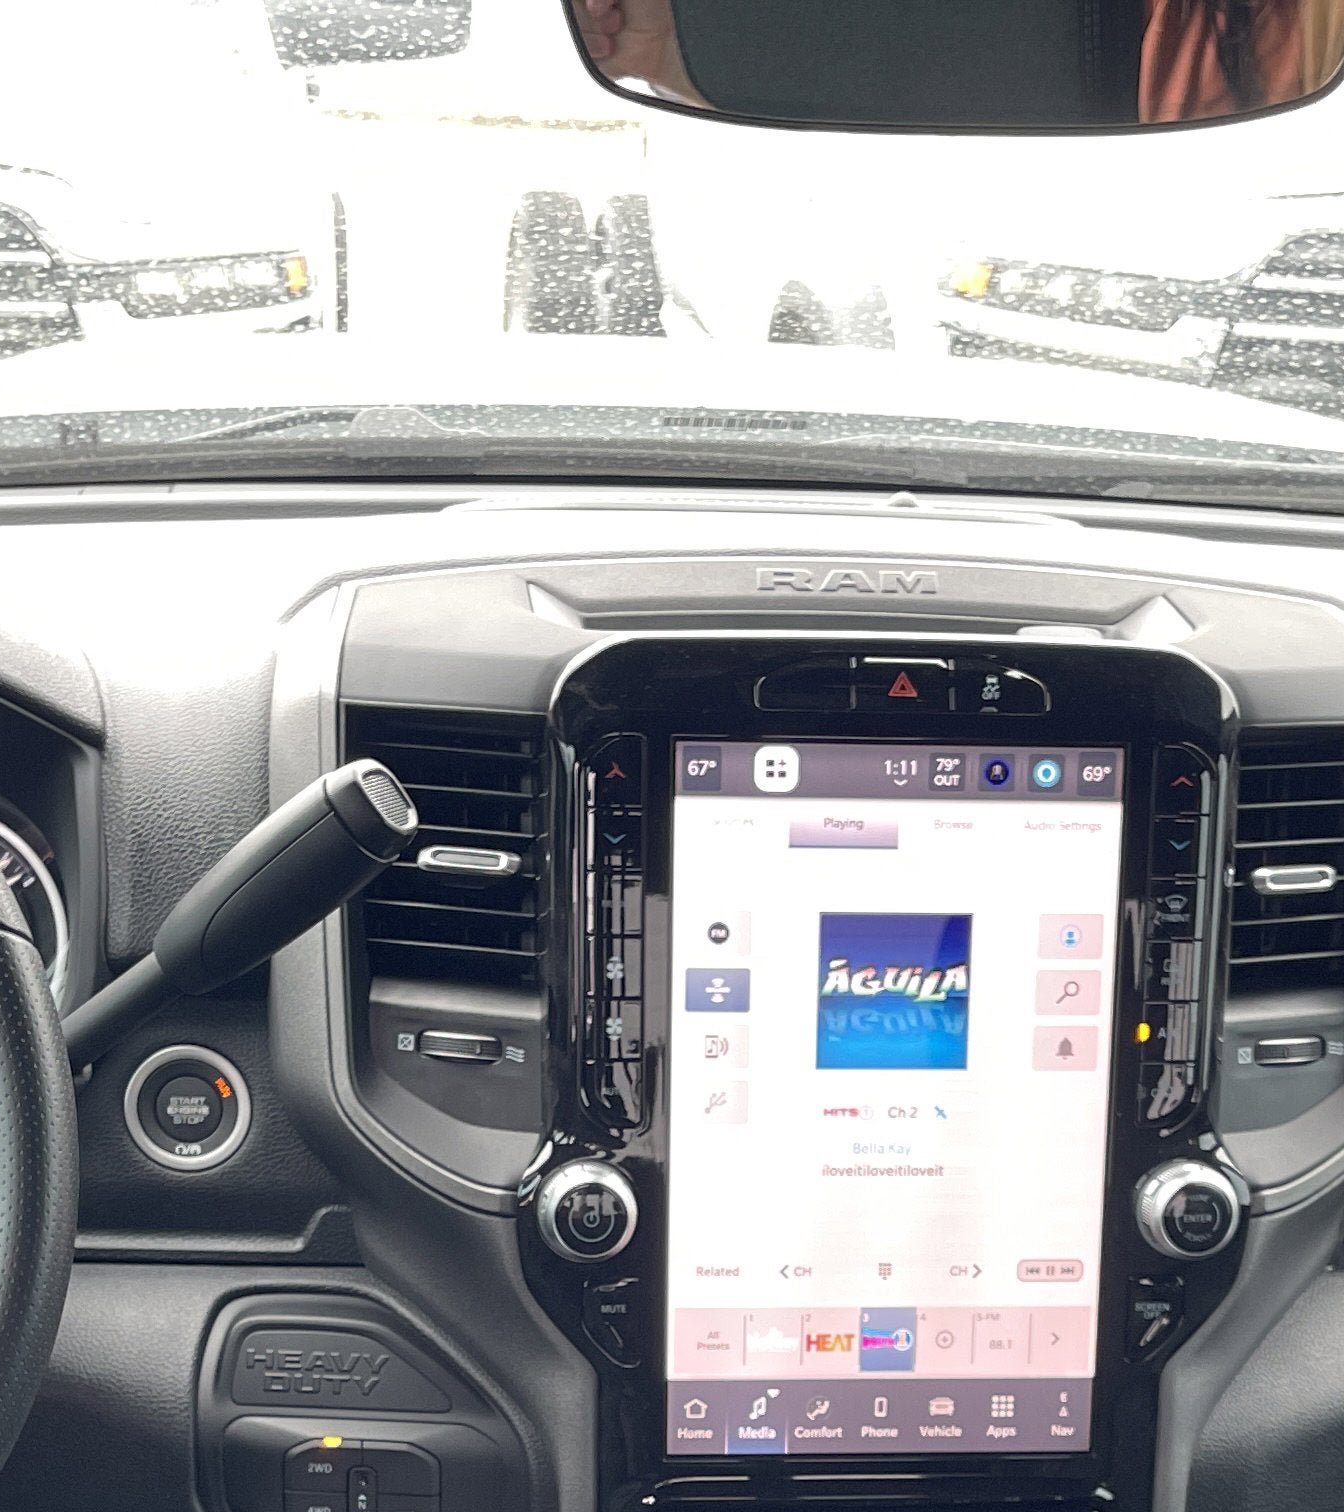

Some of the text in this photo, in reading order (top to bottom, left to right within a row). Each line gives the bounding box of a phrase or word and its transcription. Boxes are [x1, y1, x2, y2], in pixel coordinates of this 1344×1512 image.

[756, 567, 939, 594] RAM
[884, 759, 918, 776] 1:11
[933, 774, 960, 786] OUT
[823, 818, 864, 830] Playing
[887, 1106, 906, 1118] Ch
[910, 1106, 918, 1118] 2
[1184, 1214, 1212, 1223] ENTER
[696, 1266, 740, 1277] Related
[794, 1266, 812, 1277] CH
[949, 1266, 968, 1276] CH
[601, 1305, 626, 1314] MUTE
[1135, 1302, 1170, 1312] SCREEN
[805, 1334, 855, 1352] HEAT
[246, 1348, 390, 1374] HEAVY
[263, 1372, 380, 1397] DUTY
[677, 1427, 713, 1439] Home
[738, 1426, 777, 1439] Media
[794, 1426, 843, 1438] Comfort
[861, 1426, 898, 1438] Phone
[919, 1425, 963, 1437] Vehicle
[986, 1425, 1017, 1439] Apps
[1050, 1424, 1076, 1436] Nav
[308, 1463, 333, 1473] 2WD
